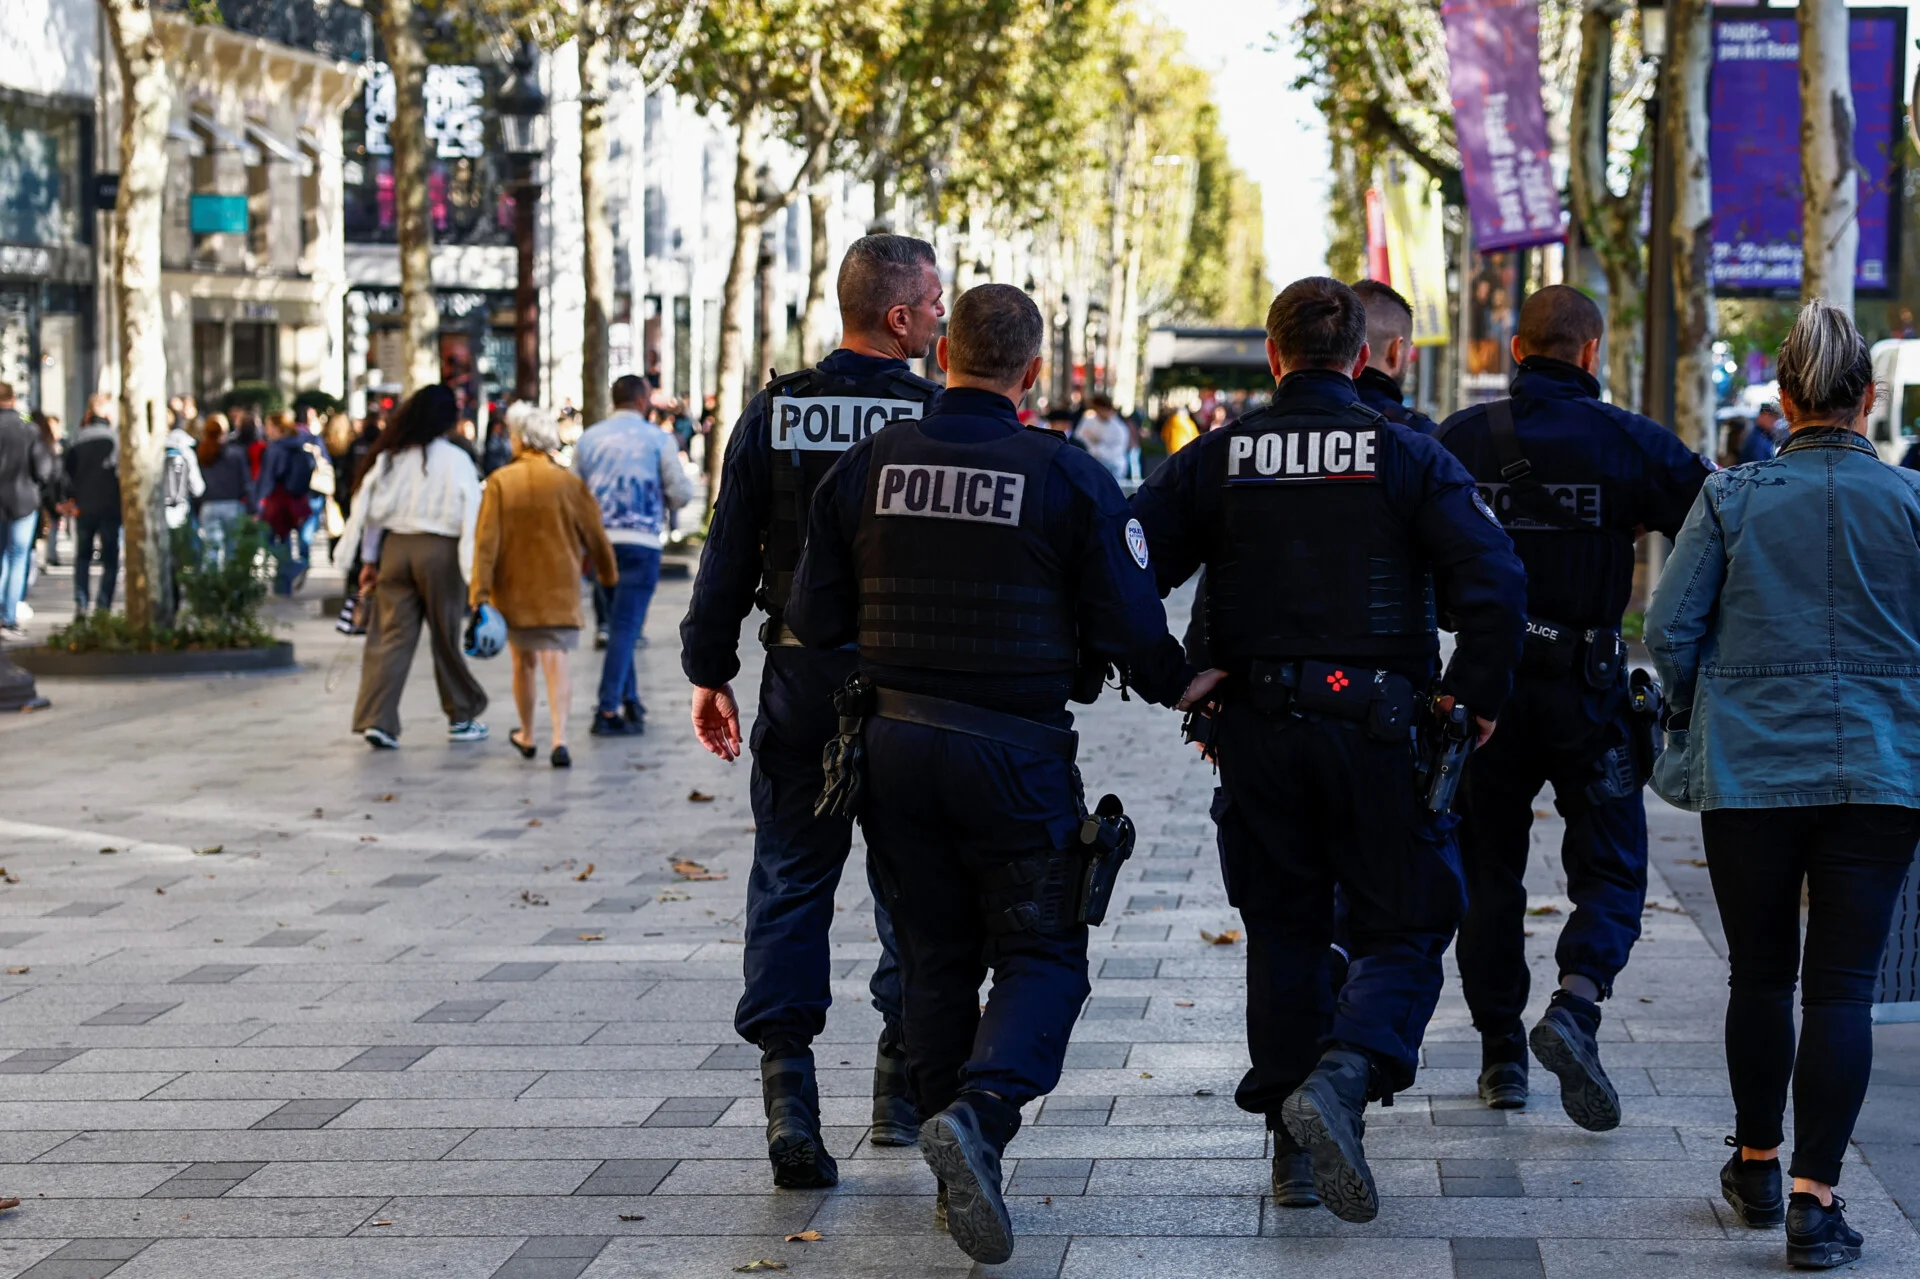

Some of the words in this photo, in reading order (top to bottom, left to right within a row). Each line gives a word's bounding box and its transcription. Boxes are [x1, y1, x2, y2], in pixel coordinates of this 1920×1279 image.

[1228, 431, 1375, 475] POLICE
[882, 468, 1016, 519] POLICE
[1526, 621, 1559, 640] OLICE
